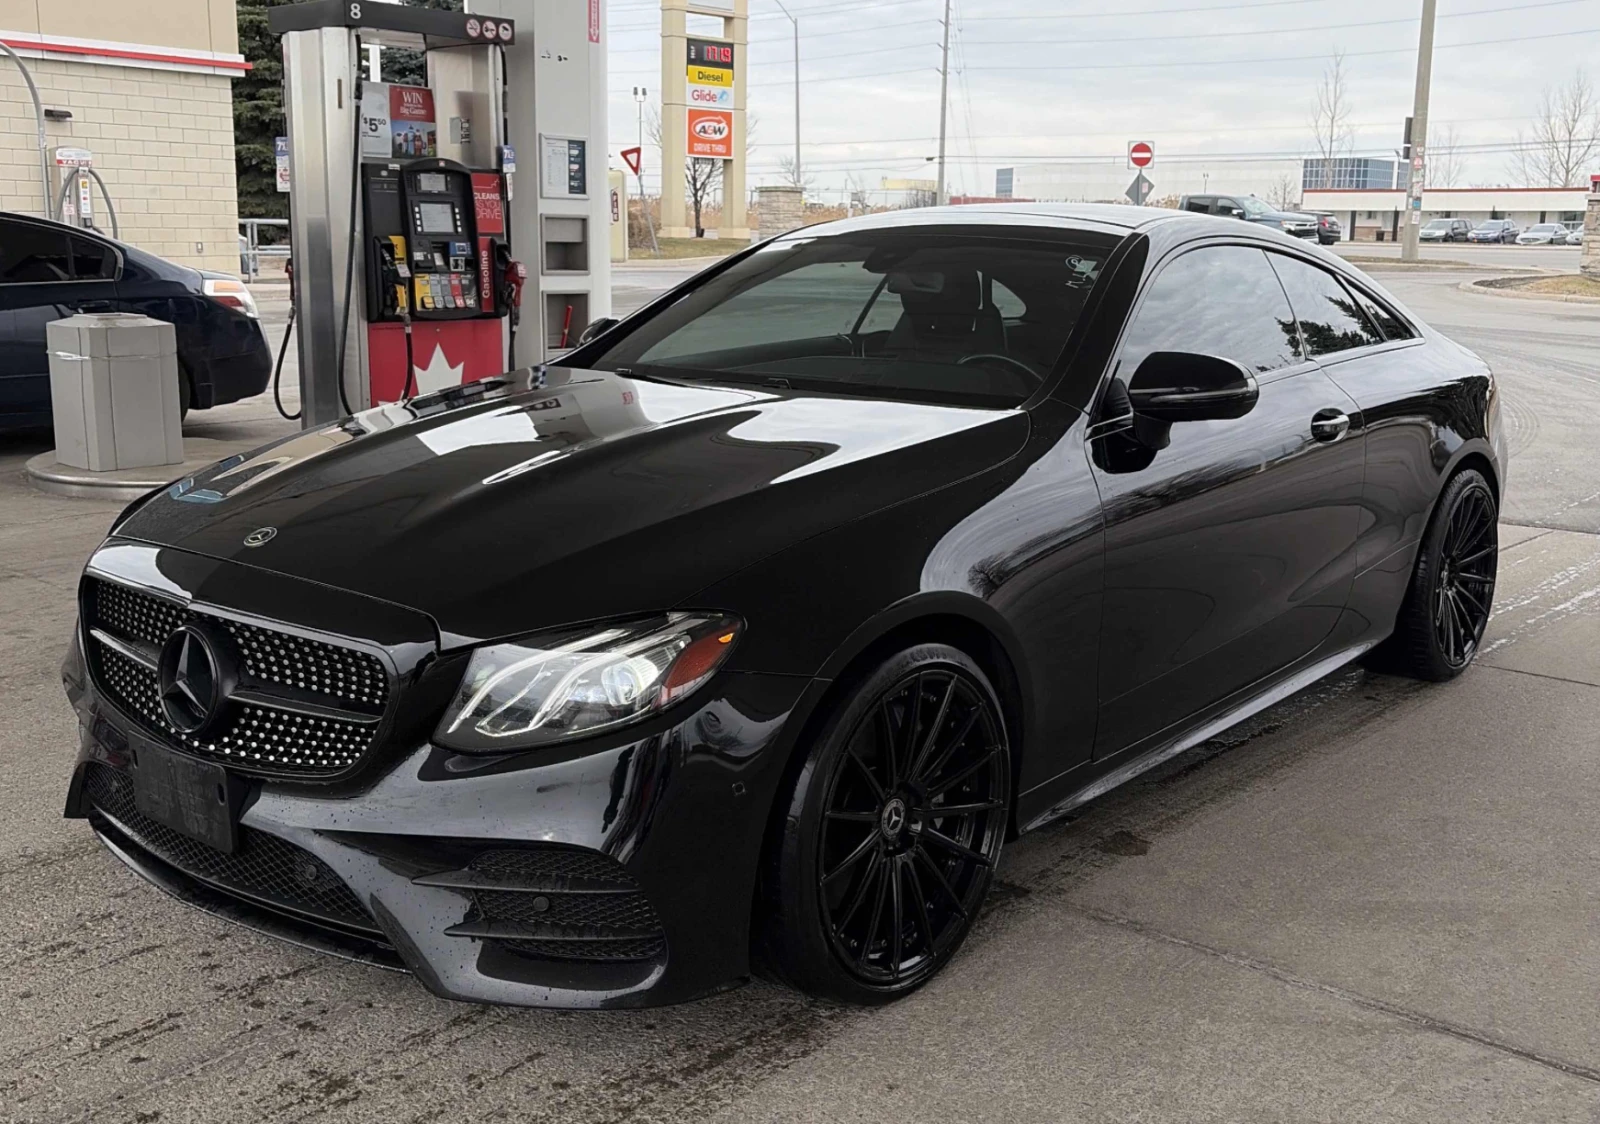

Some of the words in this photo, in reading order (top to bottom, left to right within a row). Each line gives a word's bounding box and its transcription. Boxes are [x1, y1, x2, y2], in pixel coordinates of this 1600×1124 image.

[350, 3, 361, 19] 8
[697, 70, 724, 83] Diesel
[402, 91, 423, 104] WIN
[691, 89, 717, 102] Glide
[698, 124, 726, 136] A&W
[693, 143, 711, 152] DRIVE
[712, 144, 727, 153] THRU
[485, 200, 501, 208] YOU
[482, 250, 490, 299] Gasoline
